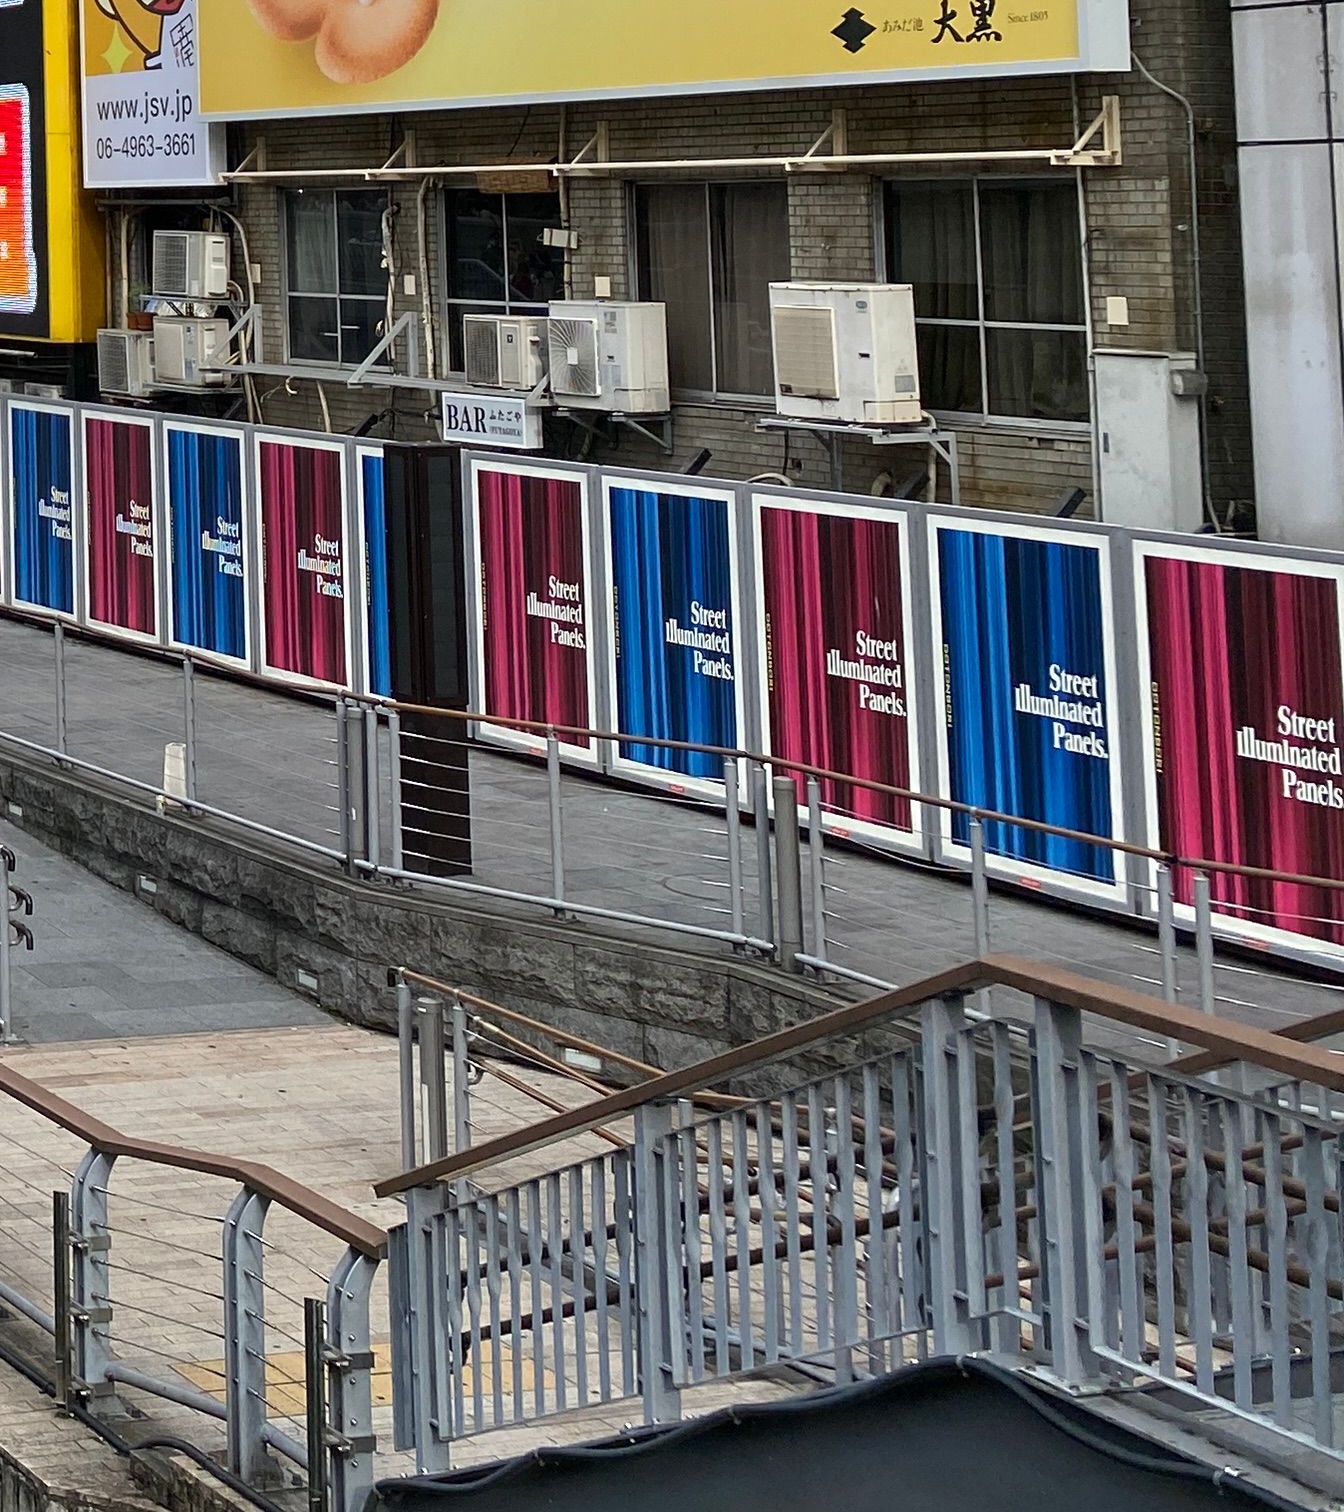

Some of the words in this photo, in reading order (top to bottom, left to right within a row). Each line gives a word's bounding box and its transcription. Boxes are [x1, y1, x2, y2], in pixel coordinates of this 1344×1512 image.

[882, 17, 924, 33] あみだ池
[1008, 12, 1029, 24] Since
[97, 88, 193, 134] www.jsv.jp
[96, 132, 196, 161] 06-4963-3661
[446, 403, 488, 434] BAR
[489, 410, 522, 423] ふたごや
[216, 516, 239, 537] Street
[314, 533, 339, 557] Street
[548, 575, 580, 601] Street
[690, 601, 727, 630] Street
[855, 630, 897, 662] Street
[943, 643, 953, 729] DOTONBORI
[1048, 663, 1099, 700] Street
[1277, 704, 1336, 744] Street
